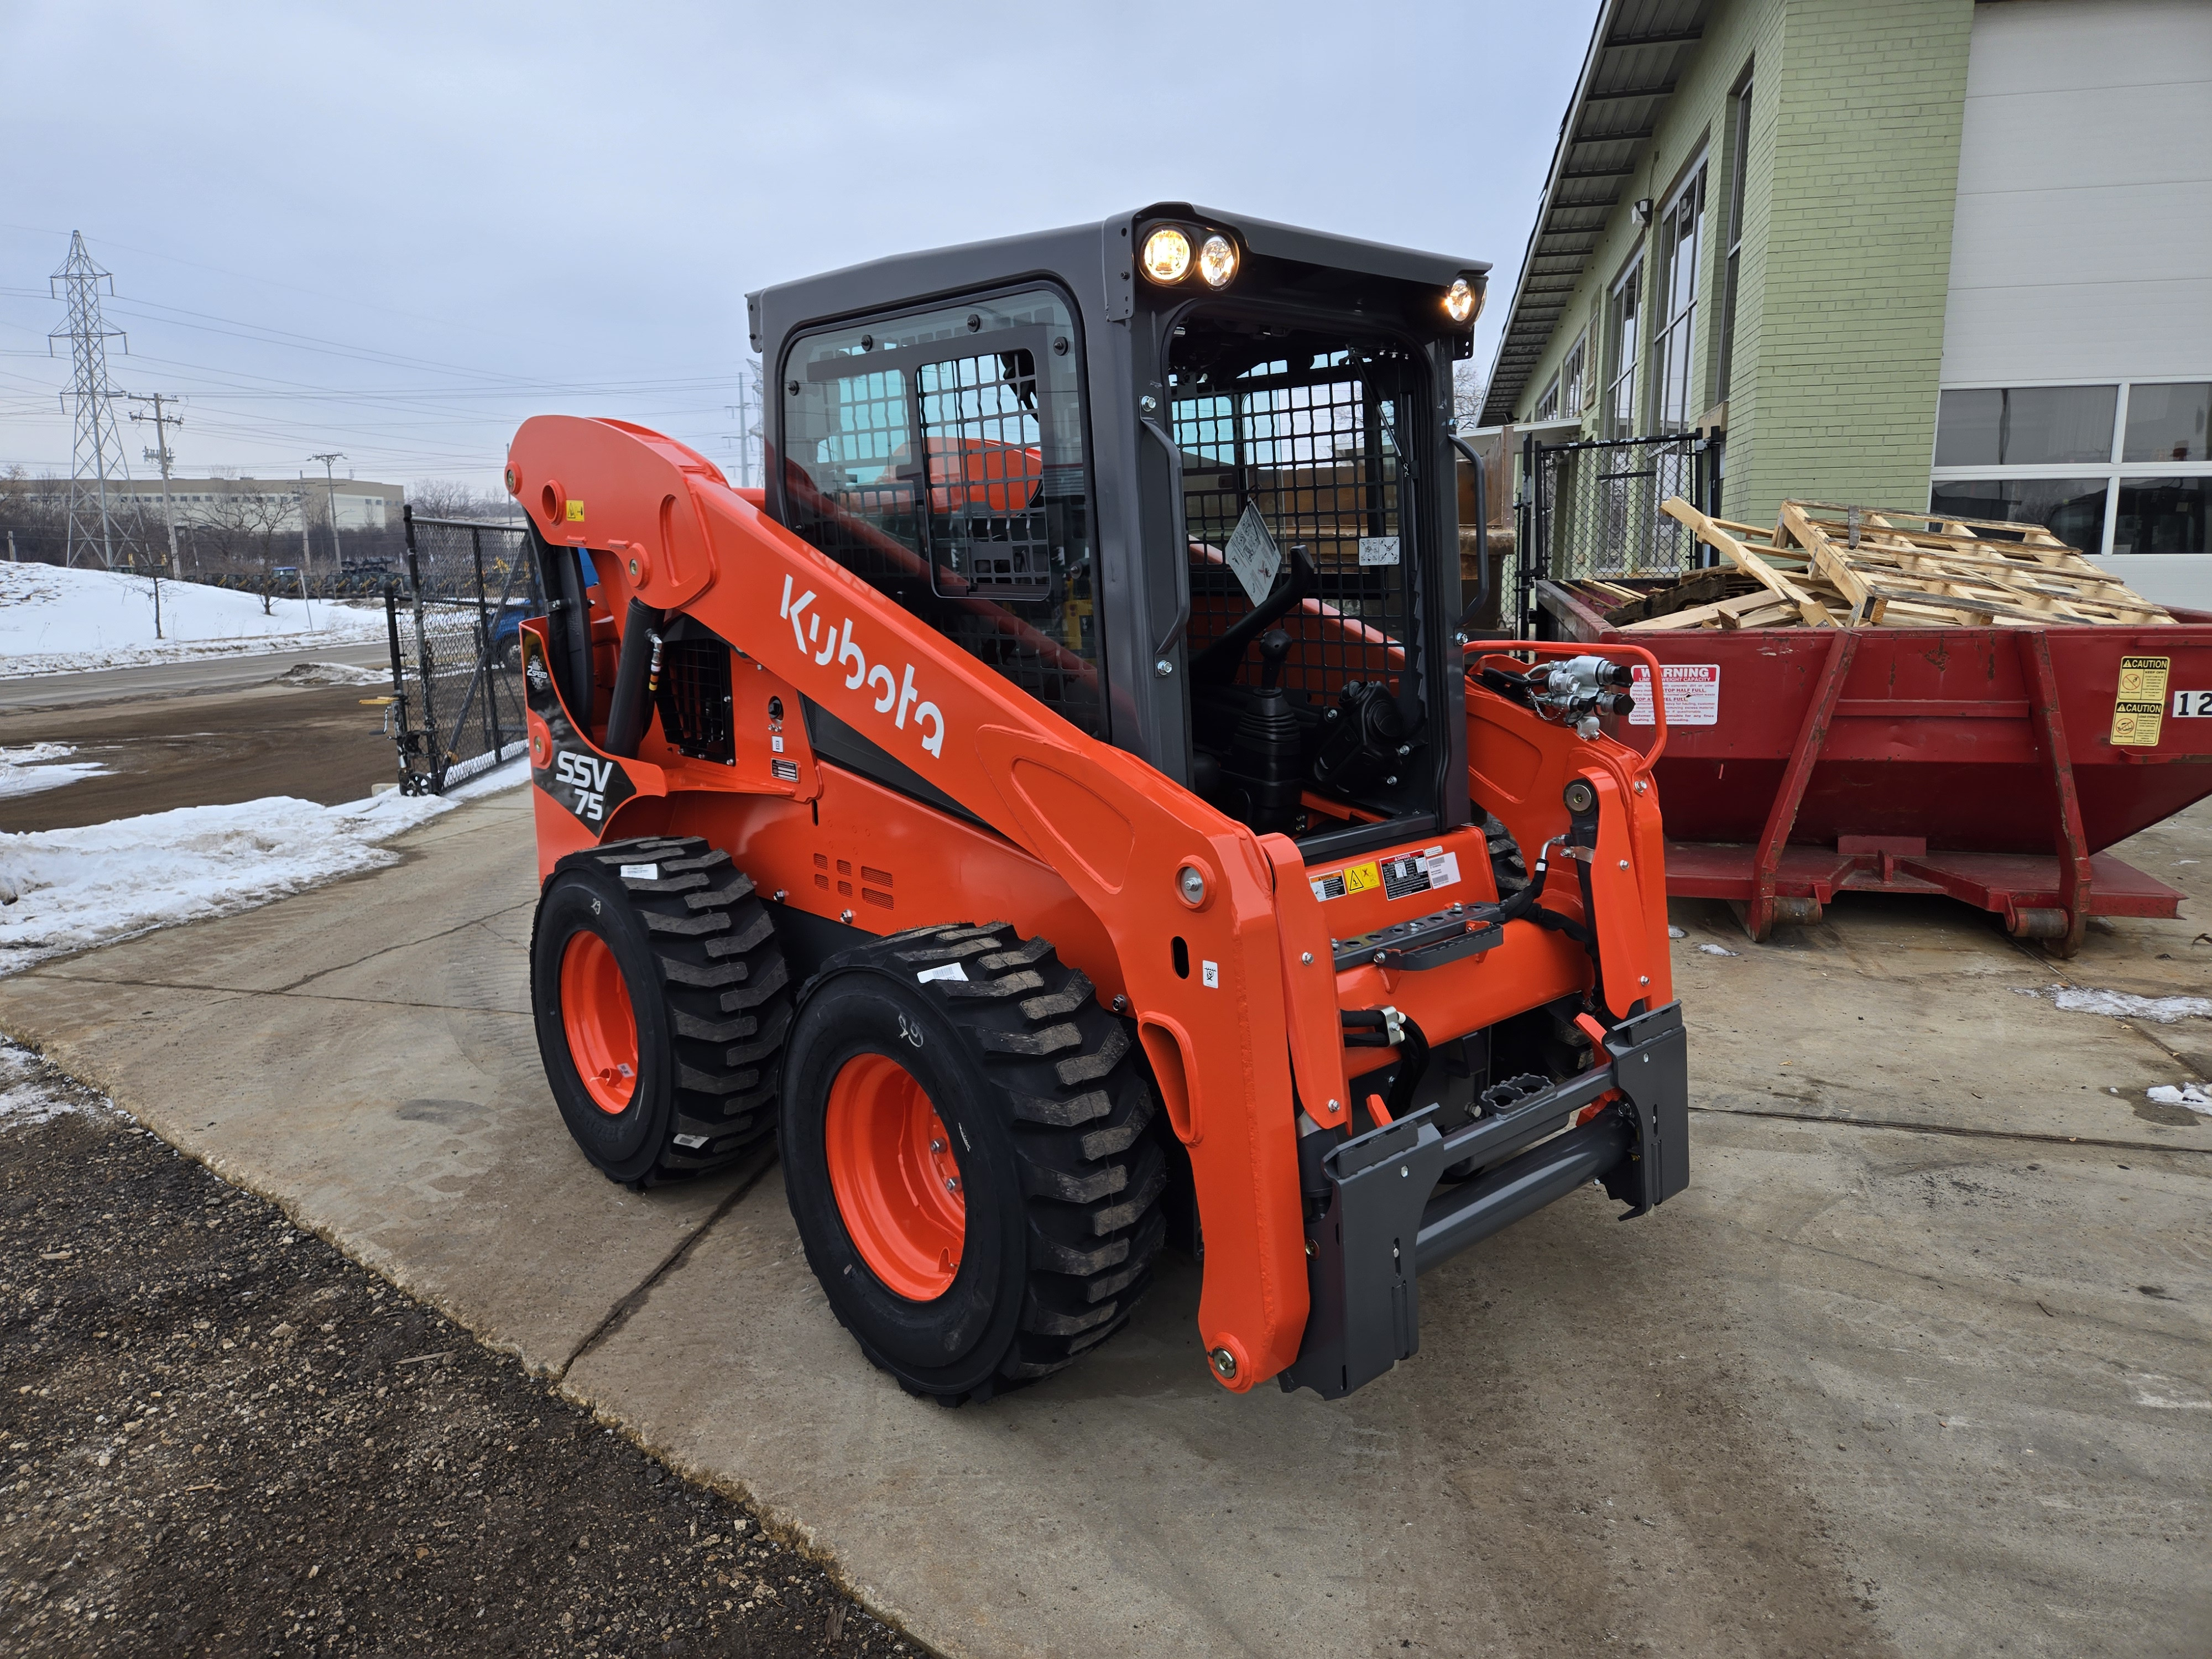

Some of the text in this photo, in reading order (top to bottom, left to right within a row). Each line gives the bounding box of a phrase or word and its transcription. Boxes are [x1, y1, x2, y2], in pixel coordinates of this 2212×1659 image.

[780, 573, 945, 759] Kubota
[1641, 668, 1709, 677] WRNING
[2132, 660, 2167, 668] CAUTION
[2126, 704, 2161, 713] CAUTION
[2178, 692, 2212, 716] 12
[556, 750, 613, 792] SSV
[575, 788, 603, 821] 75
